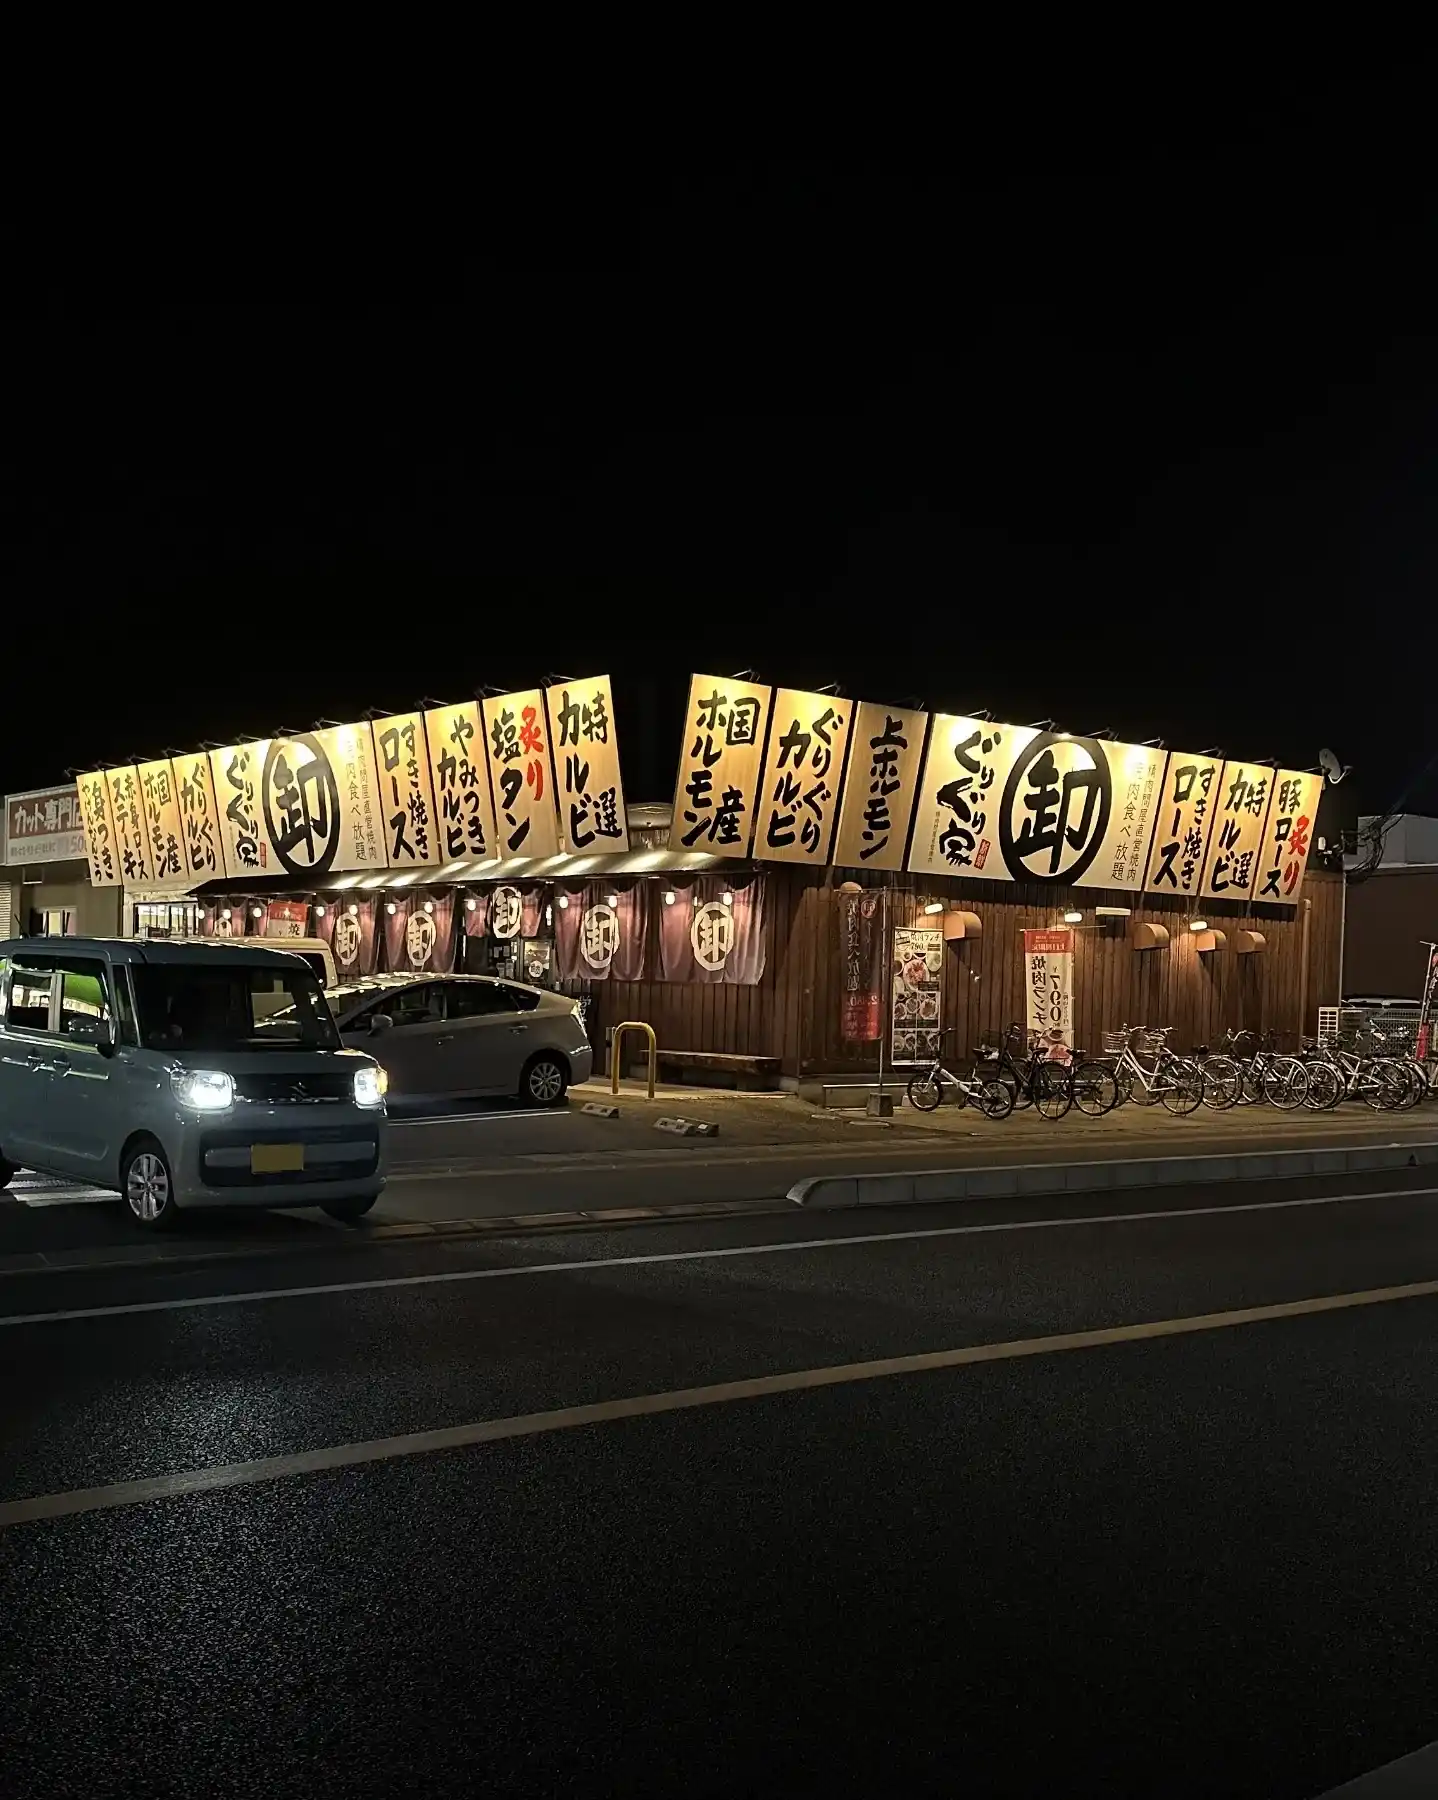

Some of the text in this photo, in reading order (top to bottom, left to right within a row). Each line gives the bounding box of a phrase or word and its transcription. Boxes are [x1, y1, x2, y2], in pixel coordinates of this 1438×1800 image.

[192, 763, 215, 871] ぐりぐり
[379, 727, 415, 860] ロース
[401, 720, 429, 860] すき焼き
[437, 748, 466, 857] カルビ
[450, 714, 486, 854] やみつき
[491, 709, 530, 851] 塩タン
[519, 706, 544, 801] 炙り
[558, 691, 595, 848] カルビ
[582, 691, 623, 838] 特選
[681, 689, 727, 847] ホルモン
[707, 697, 761, 844] 国産
[767, 720, 811, 848] カルビ
[801, 708, 843, 853] ぐりぐり
[860, 715, 908, 860] 上ホルモン
[936, 730, 1001, 866] ぐりぐり家
[144, 772, 167, 878] ホルモン
[181, 777, 205, 871] カルビ
[1153, 765, 1196, 888] ロース
[1181, 764, 1215, 889] すき焼き
[1211, 770, 1244, 892] カルビ
[1260, 779, 1302, 898] 豚ロース
[1285, 816, 1310, 895] 炙り
